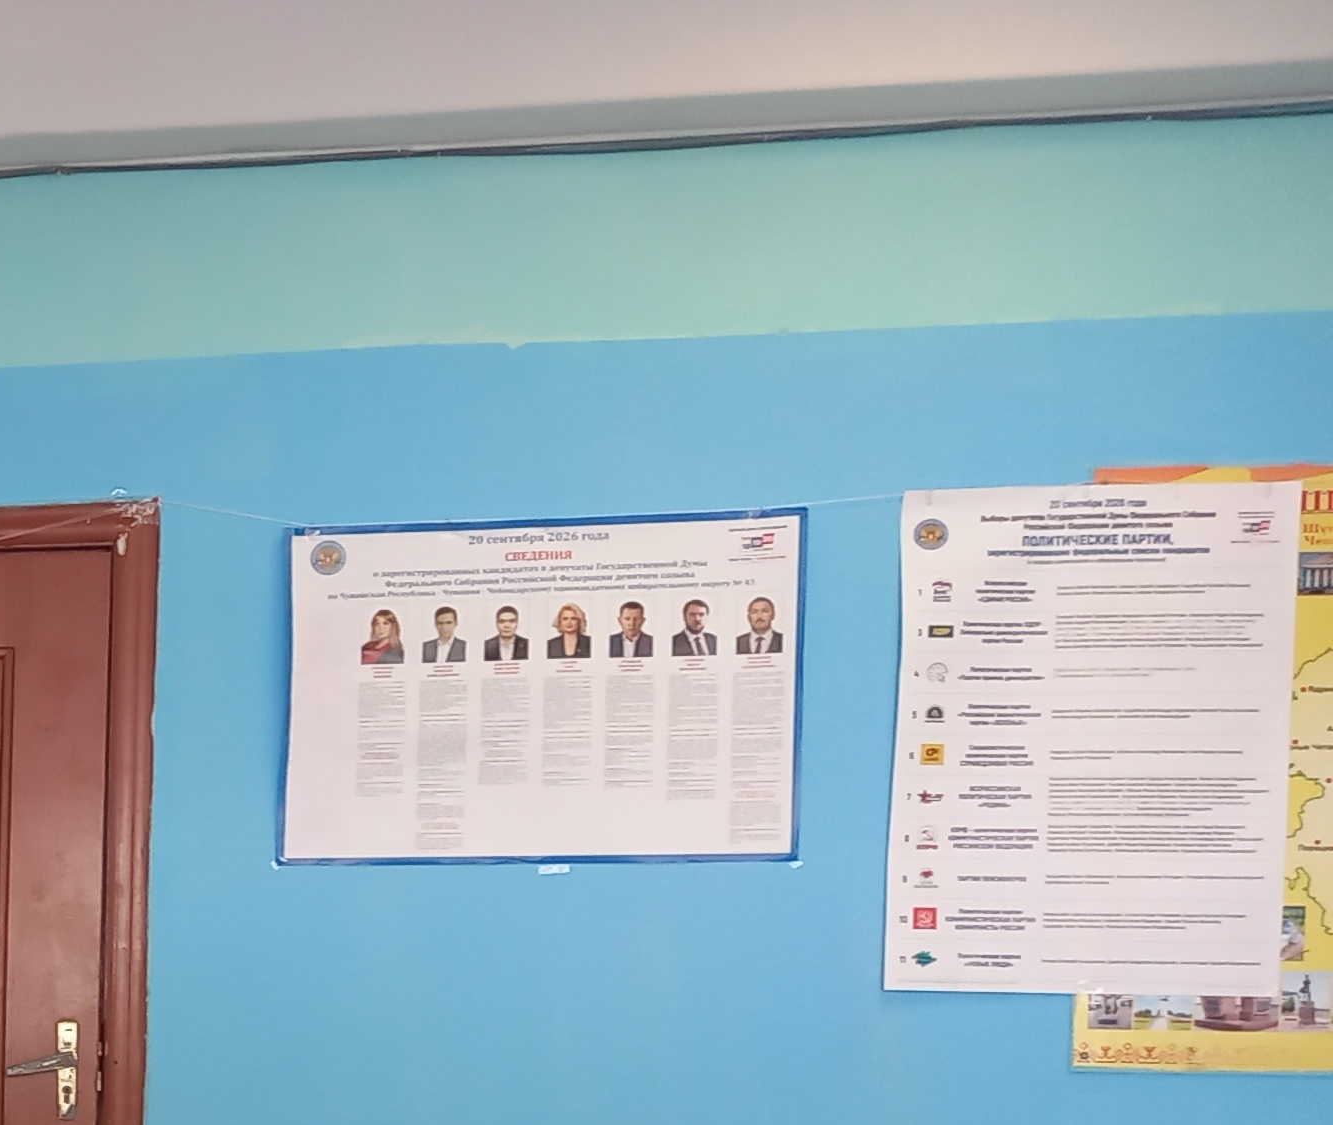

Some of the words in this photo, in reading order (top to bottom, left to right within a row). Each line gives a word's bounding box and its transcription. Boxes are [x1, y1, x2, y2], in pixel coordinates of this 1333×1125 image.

[468, 535, 484, 545] 20
[487, 533, 544, 545] сентября
[547, 531, 579, 542] 2026
[581, 531, 609, 541] года
[1022, 534, 1119, 547] ПОЛИТИЧЕСКИЕ
[1122, 533, 1174, 546] ПАРТИИ,
[505, 550, 573, 562] СВЕДЕНИЯ
